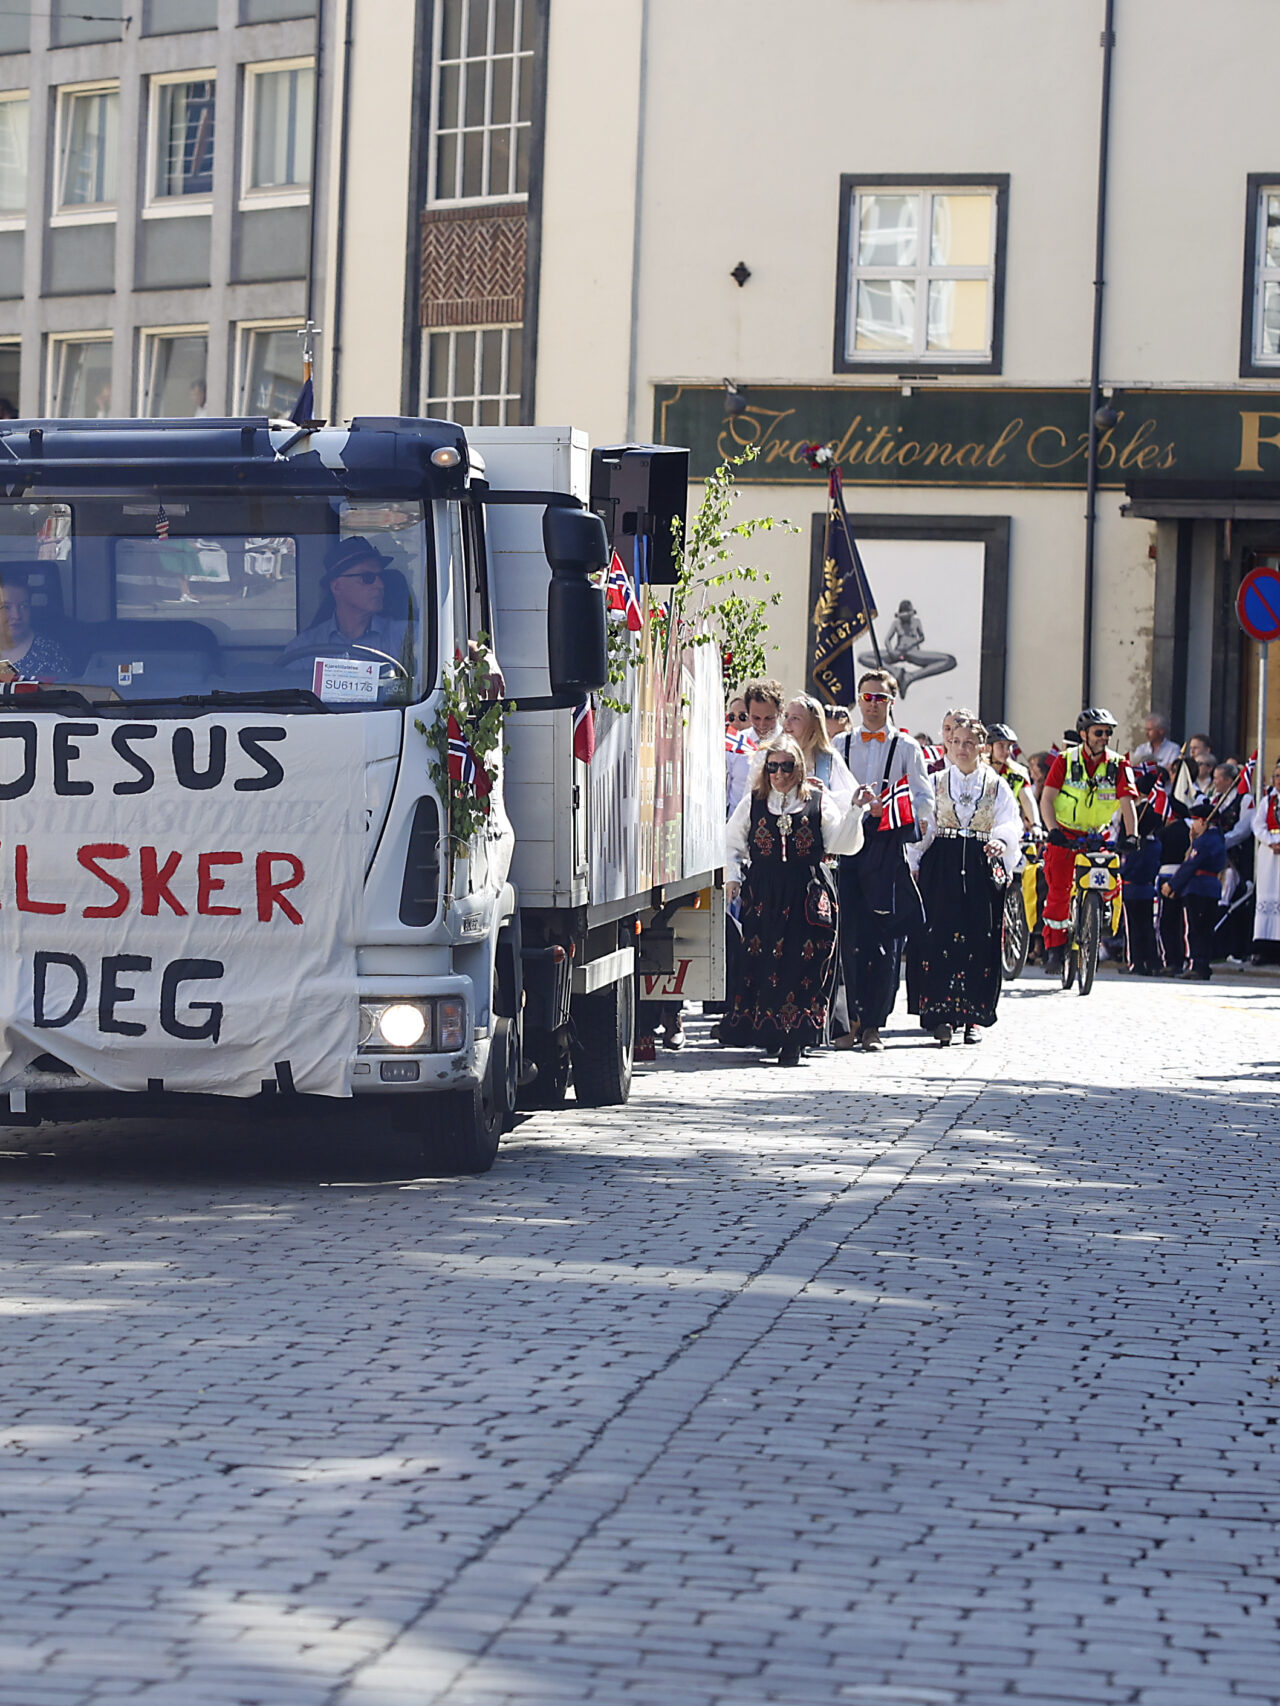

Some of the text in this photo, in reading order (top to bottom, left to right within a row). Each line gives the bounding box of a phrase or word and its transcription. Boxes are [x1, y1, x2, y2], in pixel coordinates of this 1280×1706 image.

[717, 405, 1023, 468] Traditional
[325, 679, 373, 692] SU61175
[366, 665, 373, 675] 4
[33, 949, 225, 1043] DEG
